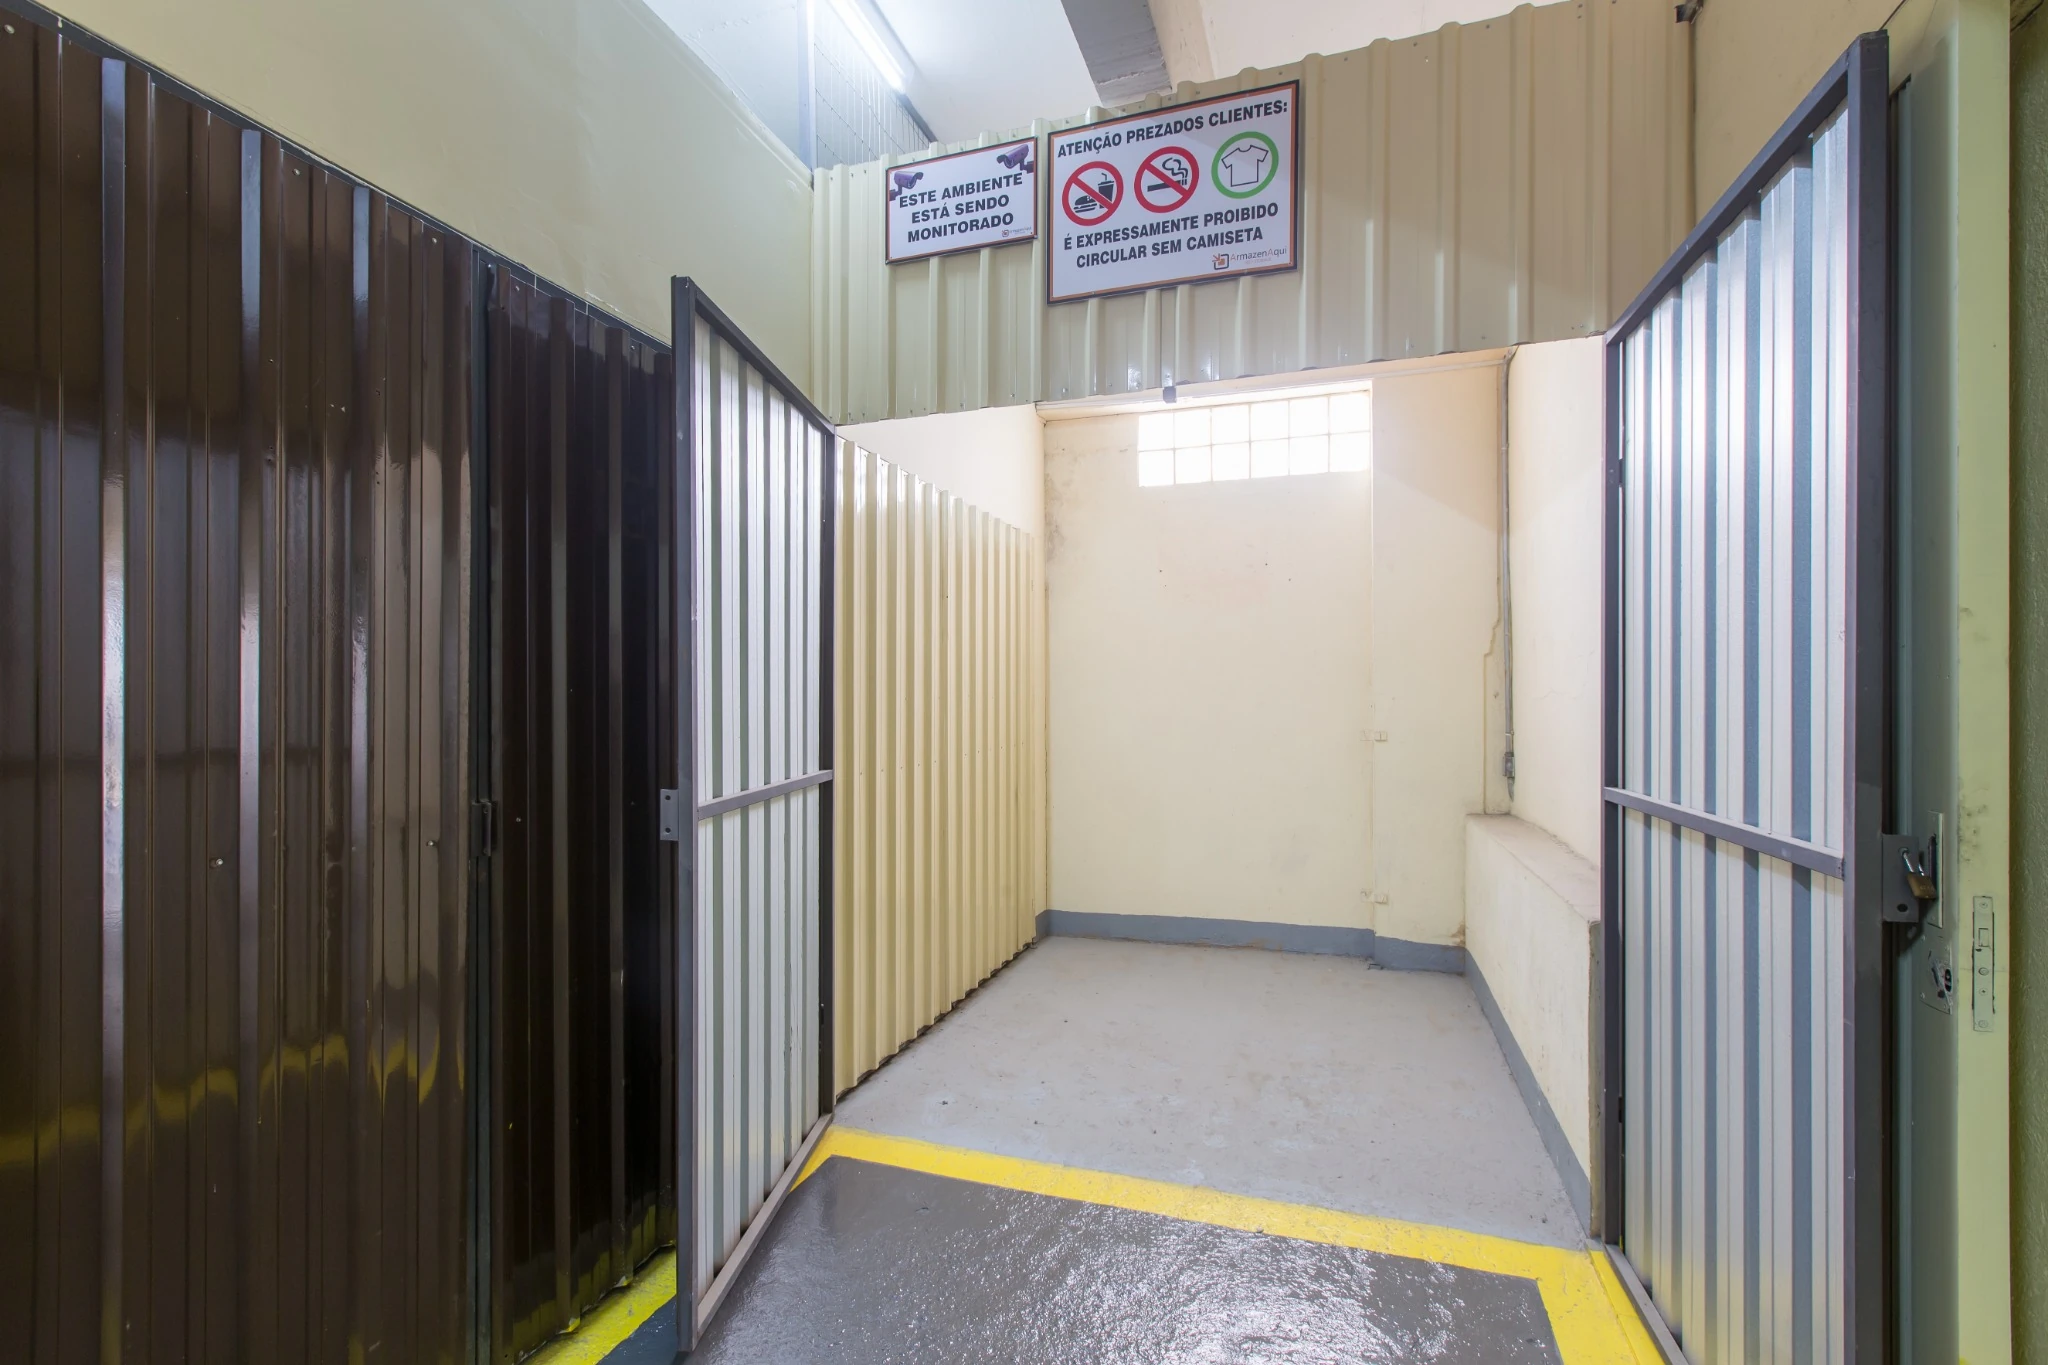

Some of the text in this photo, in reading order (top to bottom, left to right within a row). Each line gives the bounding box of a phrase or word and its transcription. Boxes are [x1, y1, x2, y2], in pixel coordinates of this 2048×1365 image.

[1058, 100, 1288, 157] ATENÇÃO PREZADOS CLIENTES:
[900, 173, 1022, 208] ESTE AMBIENTE
[912, 194, 1009, 223] ESTÁ SENDO
[908, 212, 1013, 242] MONITORADO
[1064, 202, 1278, 250] É EXPRESSAMENTE PROIBIDO
[1076, 226, 1263, 268] CIRCULAR SEM CAMISETA
